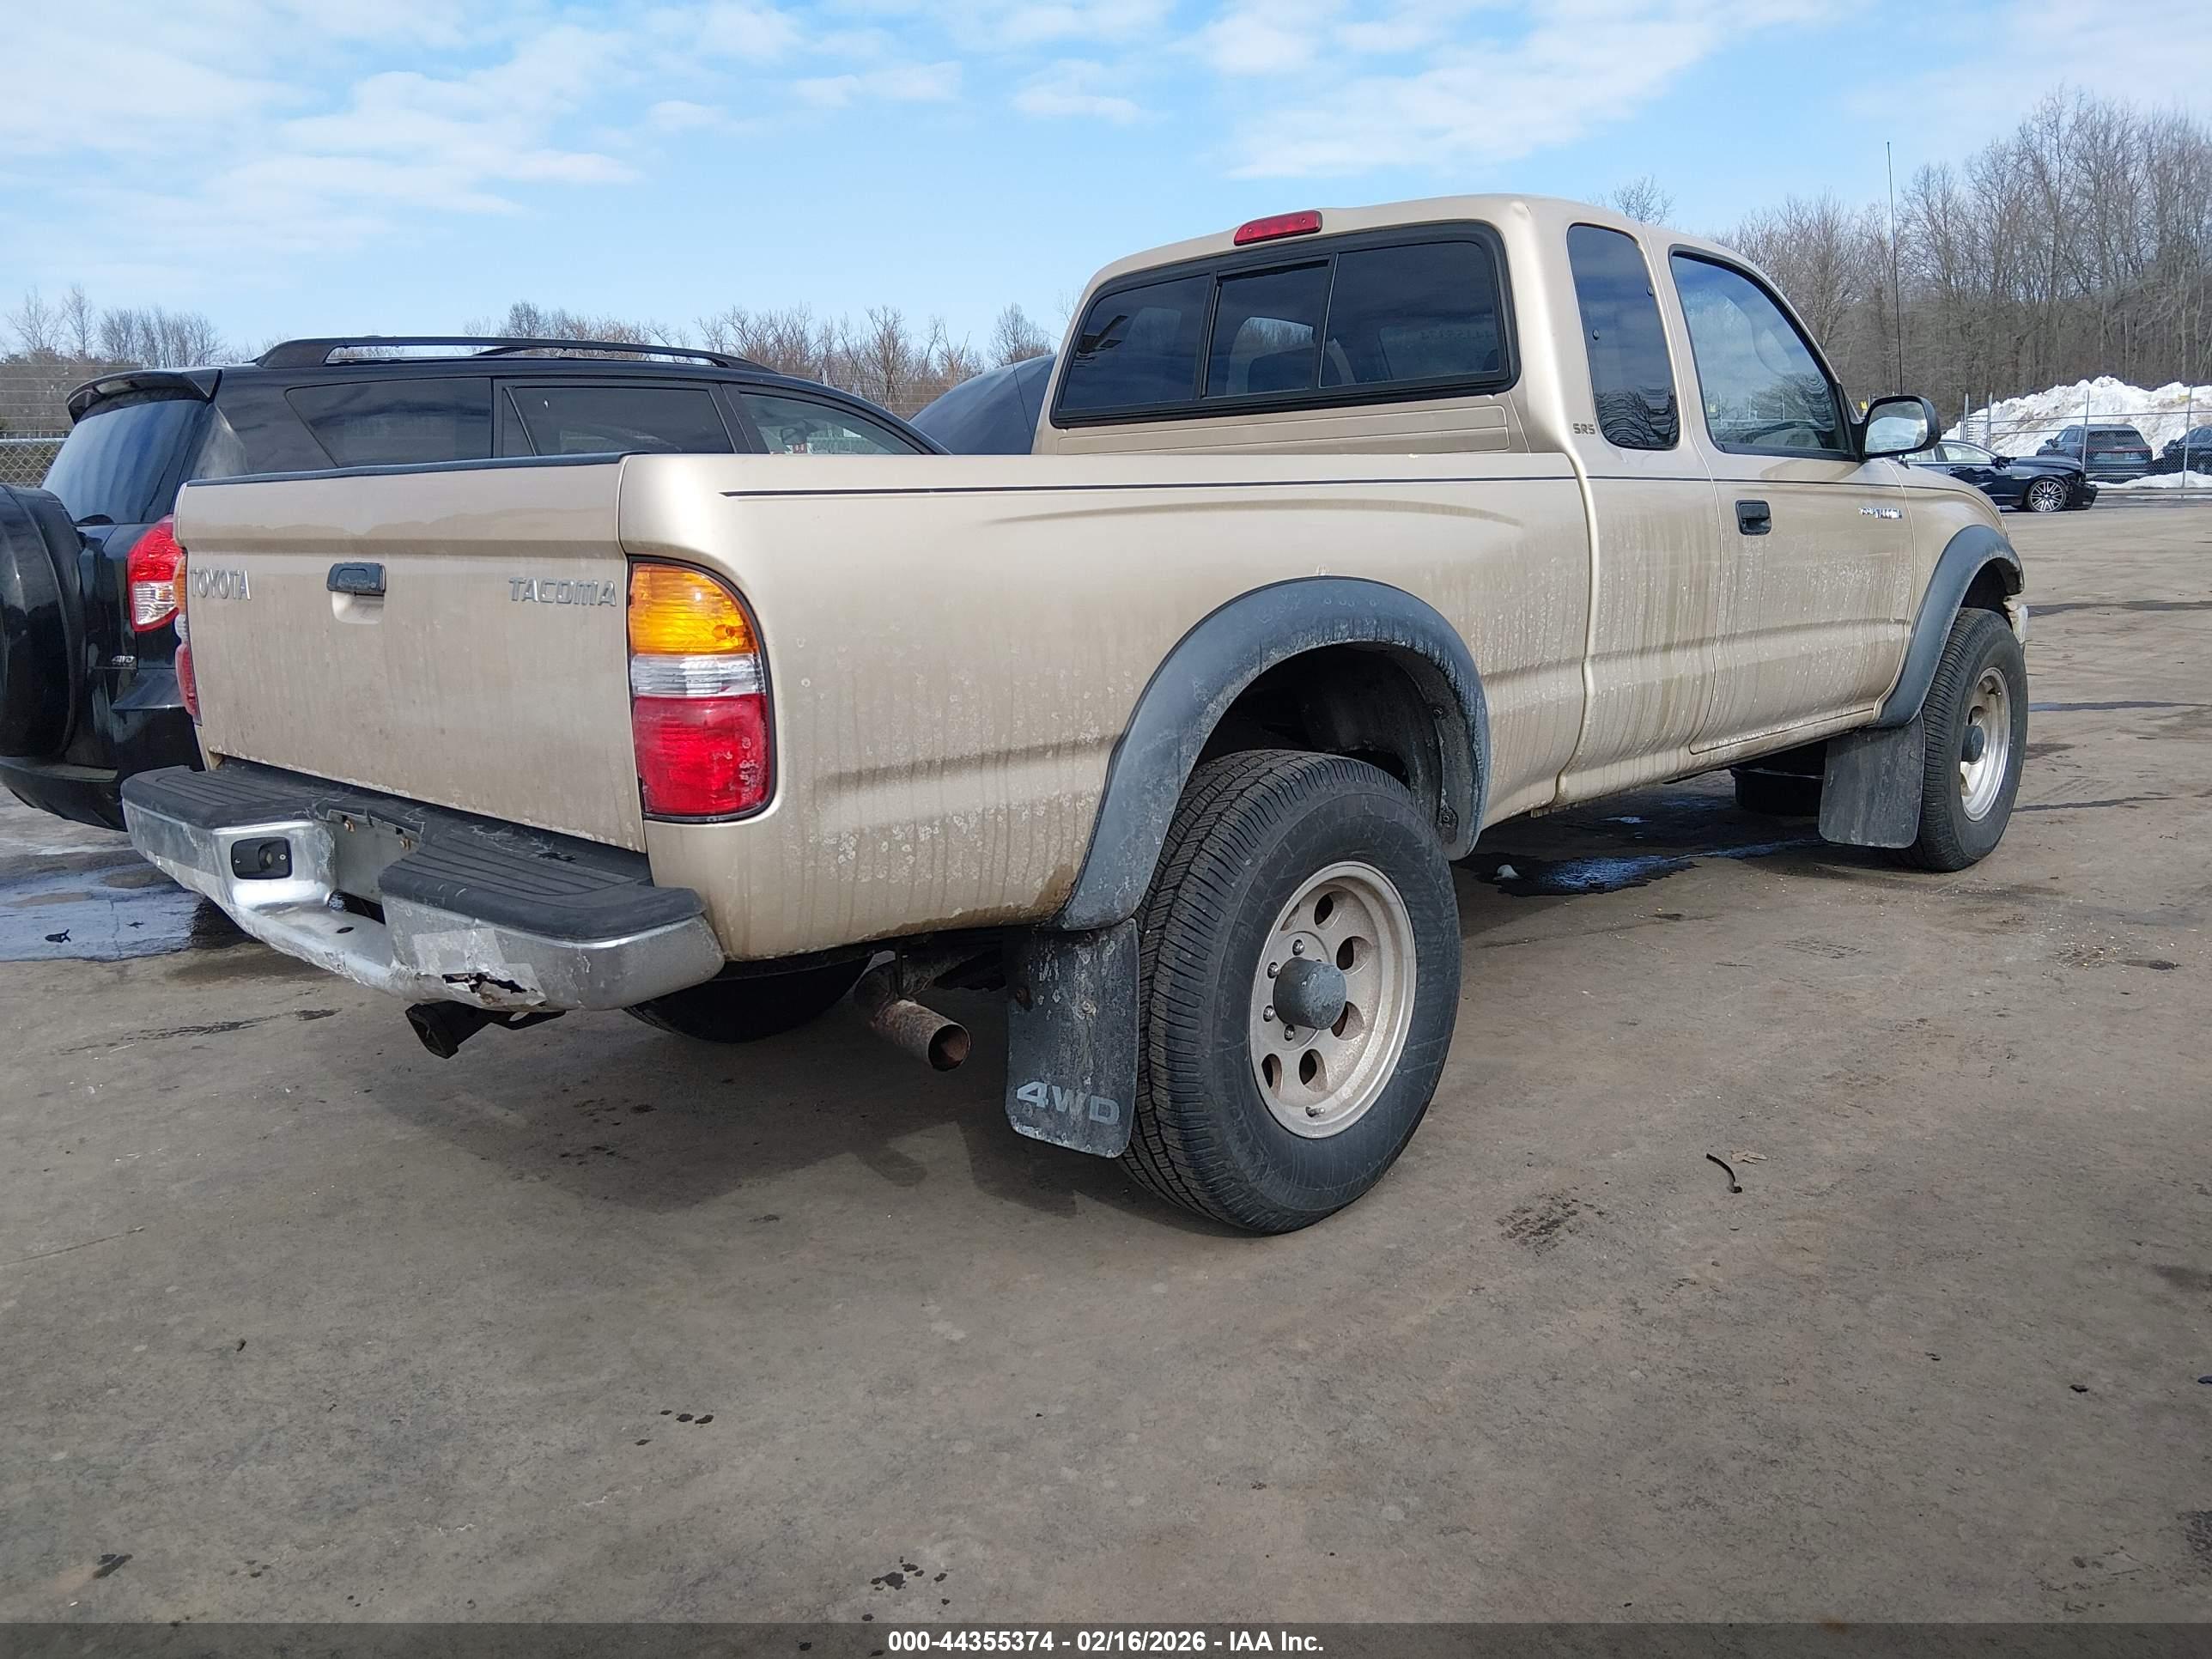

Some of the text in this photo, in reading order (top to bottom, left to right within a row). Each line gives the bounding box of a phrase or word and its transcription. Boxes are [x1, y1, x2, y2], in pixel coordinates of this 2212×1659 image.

[190, 568, 252, 600] TOYOTA
[508, 577, 617, 606] TACOMA
[1016, 1081, 1120, 1126] 4WD
